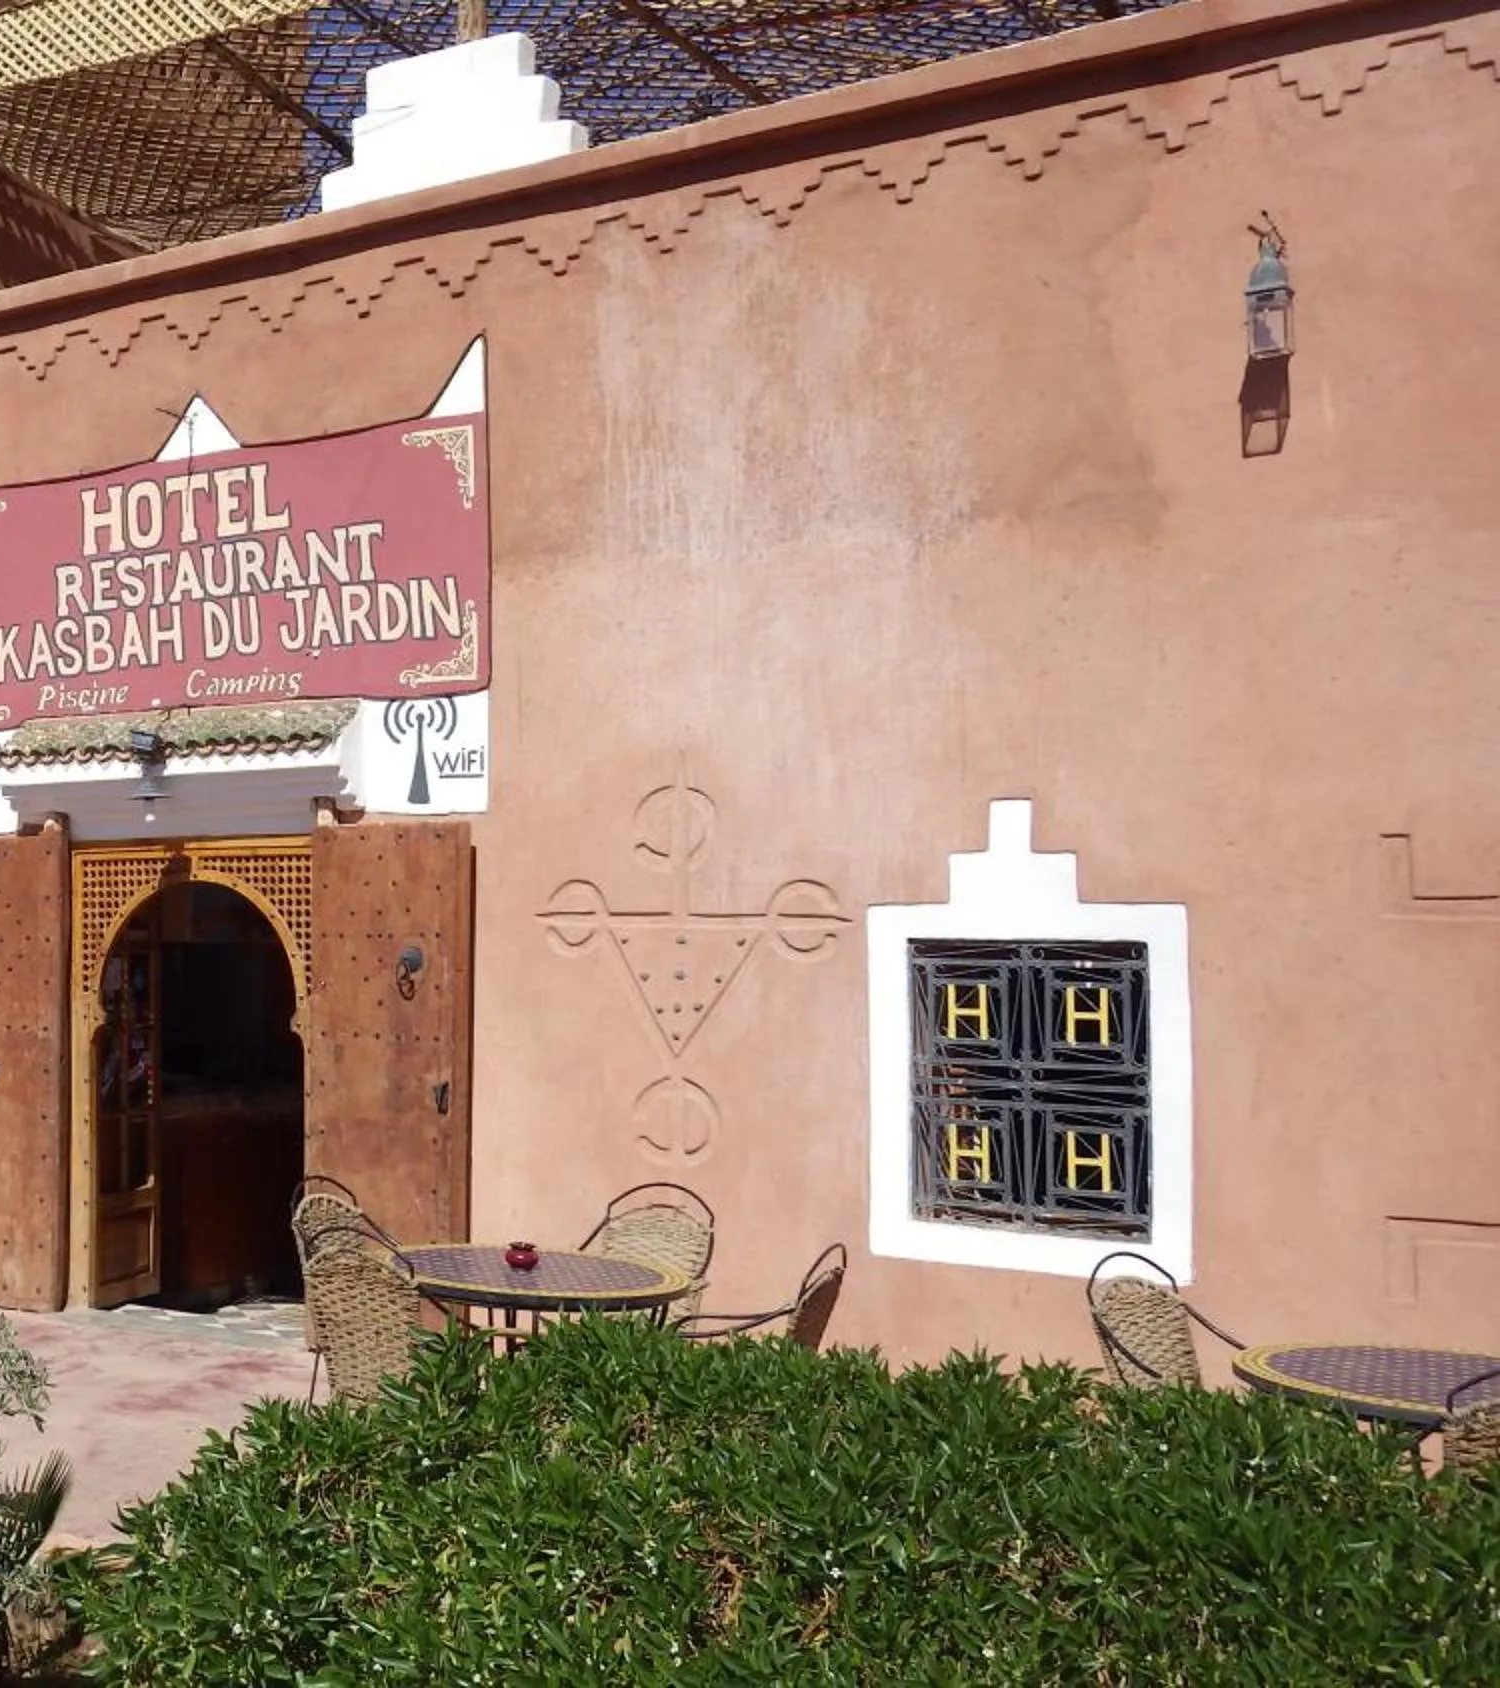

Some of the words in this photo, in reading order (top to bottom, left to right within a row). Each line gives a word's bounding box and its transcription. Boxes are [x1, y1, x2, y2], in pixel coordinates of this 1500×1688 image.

[81, 463, 290, 556] HOTEL
[55, 523, 383, 618] RESTAURANT
[204, 594, 261, 660] DU
[280, 577, 463, 653] JARDIN
[186, 668, 303, 698] Camping
